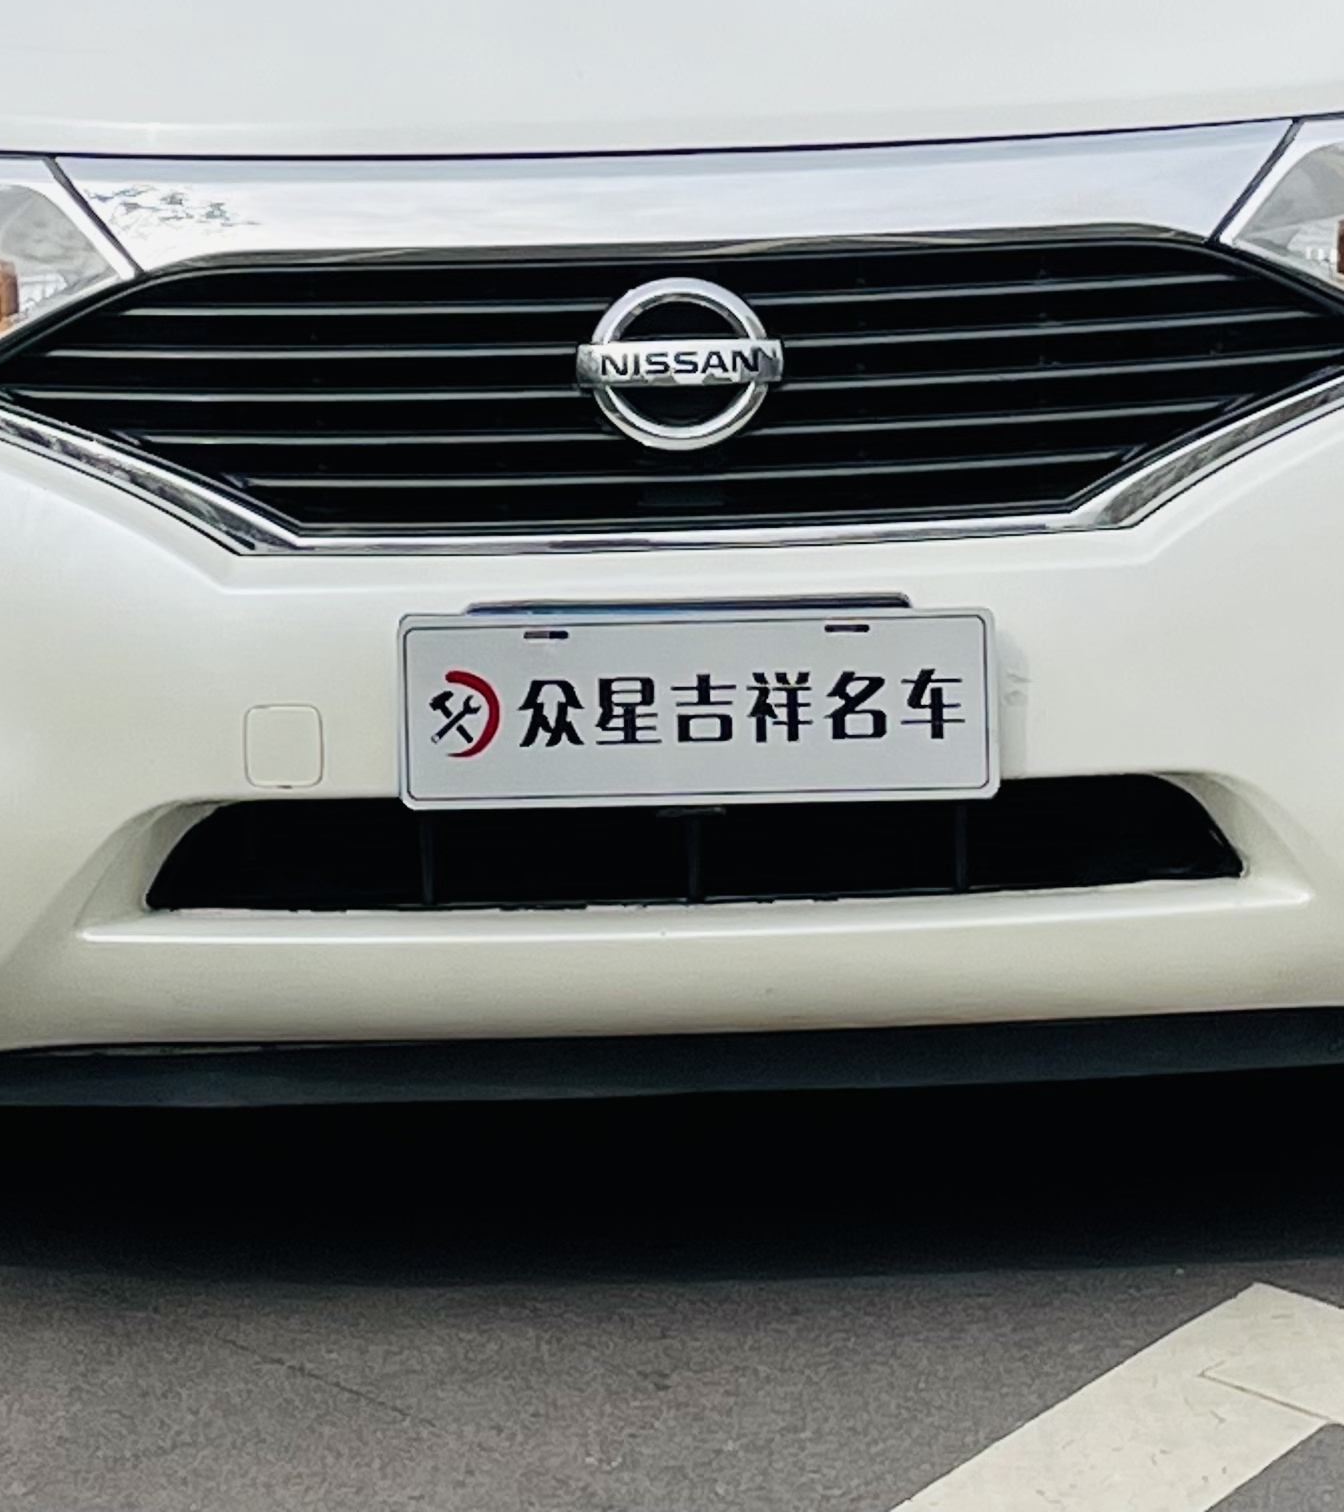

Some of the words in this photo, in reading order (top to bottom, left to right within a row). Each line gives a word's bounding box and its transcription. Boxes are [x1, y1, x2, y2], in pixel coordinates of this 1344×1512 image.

[600, 346, 761, 377] NISSAN
[518, 668, 966, 748] 众星吉祥名车
